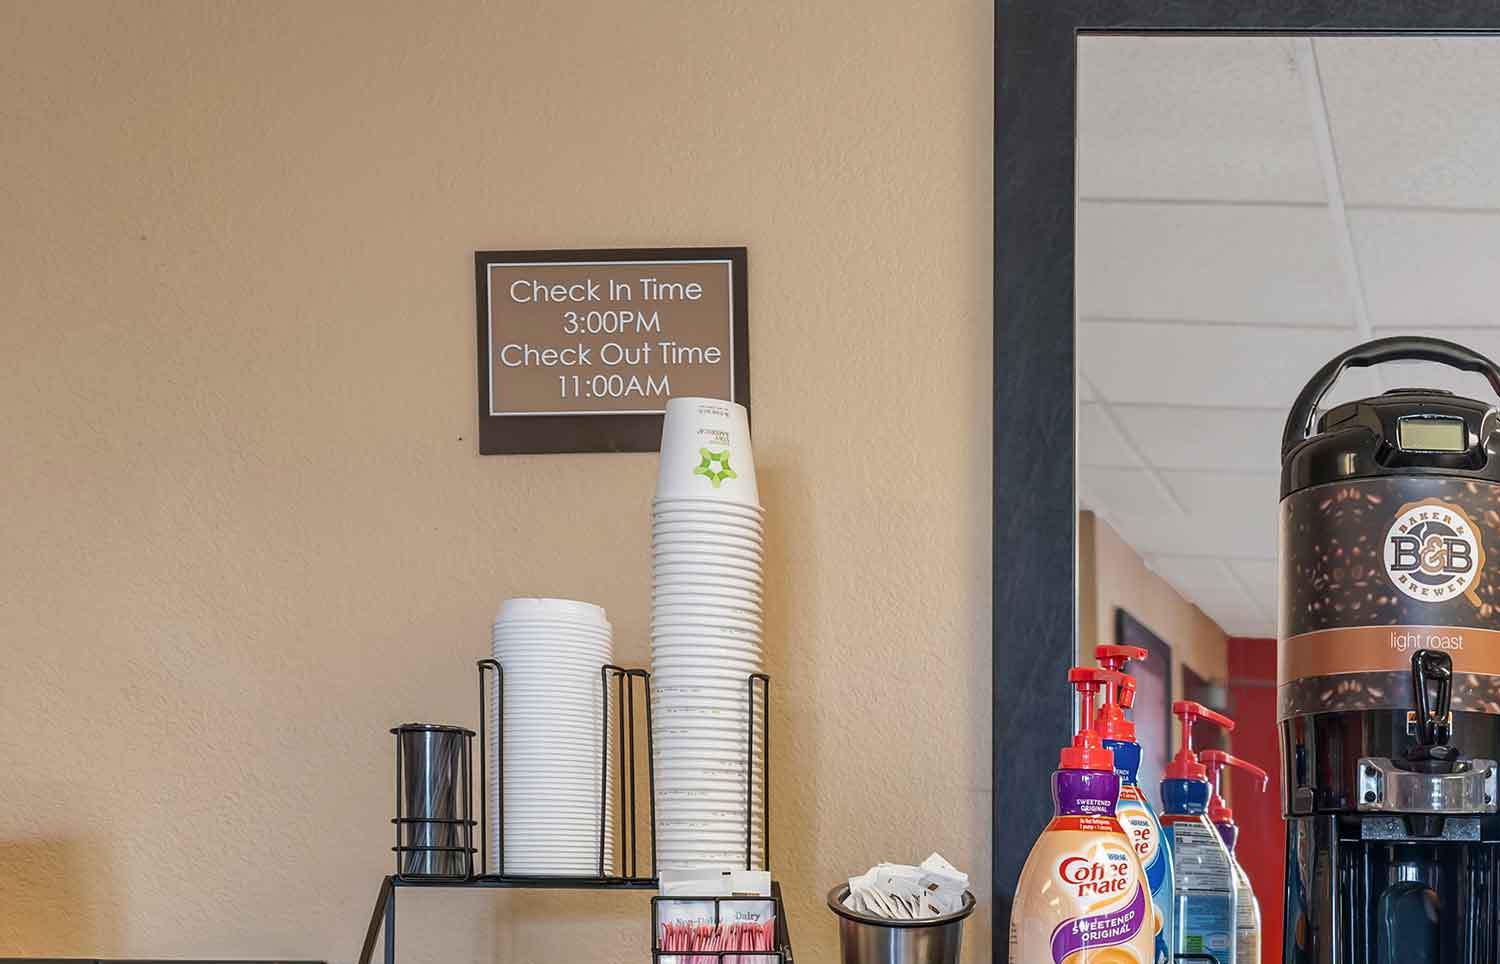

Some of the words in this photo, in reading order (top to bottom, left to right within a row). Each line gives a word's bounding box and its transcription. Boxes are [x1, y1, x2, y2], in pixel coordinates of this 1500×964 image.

[509, 279, 601, 303] Check
[609, 280, 632, 301] In
[639, 278, 703, 301] Time
[563, 311, 661, 334] 3:00PM
[500, 344, 592, 367] Check
[600, 343, 651, 366] Out
[658, 342, 721, 365] Time
[559, 375, 671, 399] 11:00AM
[1398, 511, 1452, 534] BAKER
[1390, 534, 1473, 574] B&B
[1398, 575, 1466, 597] BREWER
[1390, 632, 1421, 650] light
[1426, 634, 1464, 651] roast
[735, 911, 760, 921] Dairy
[1081, 924, 1131, 941] ORIGINAL
